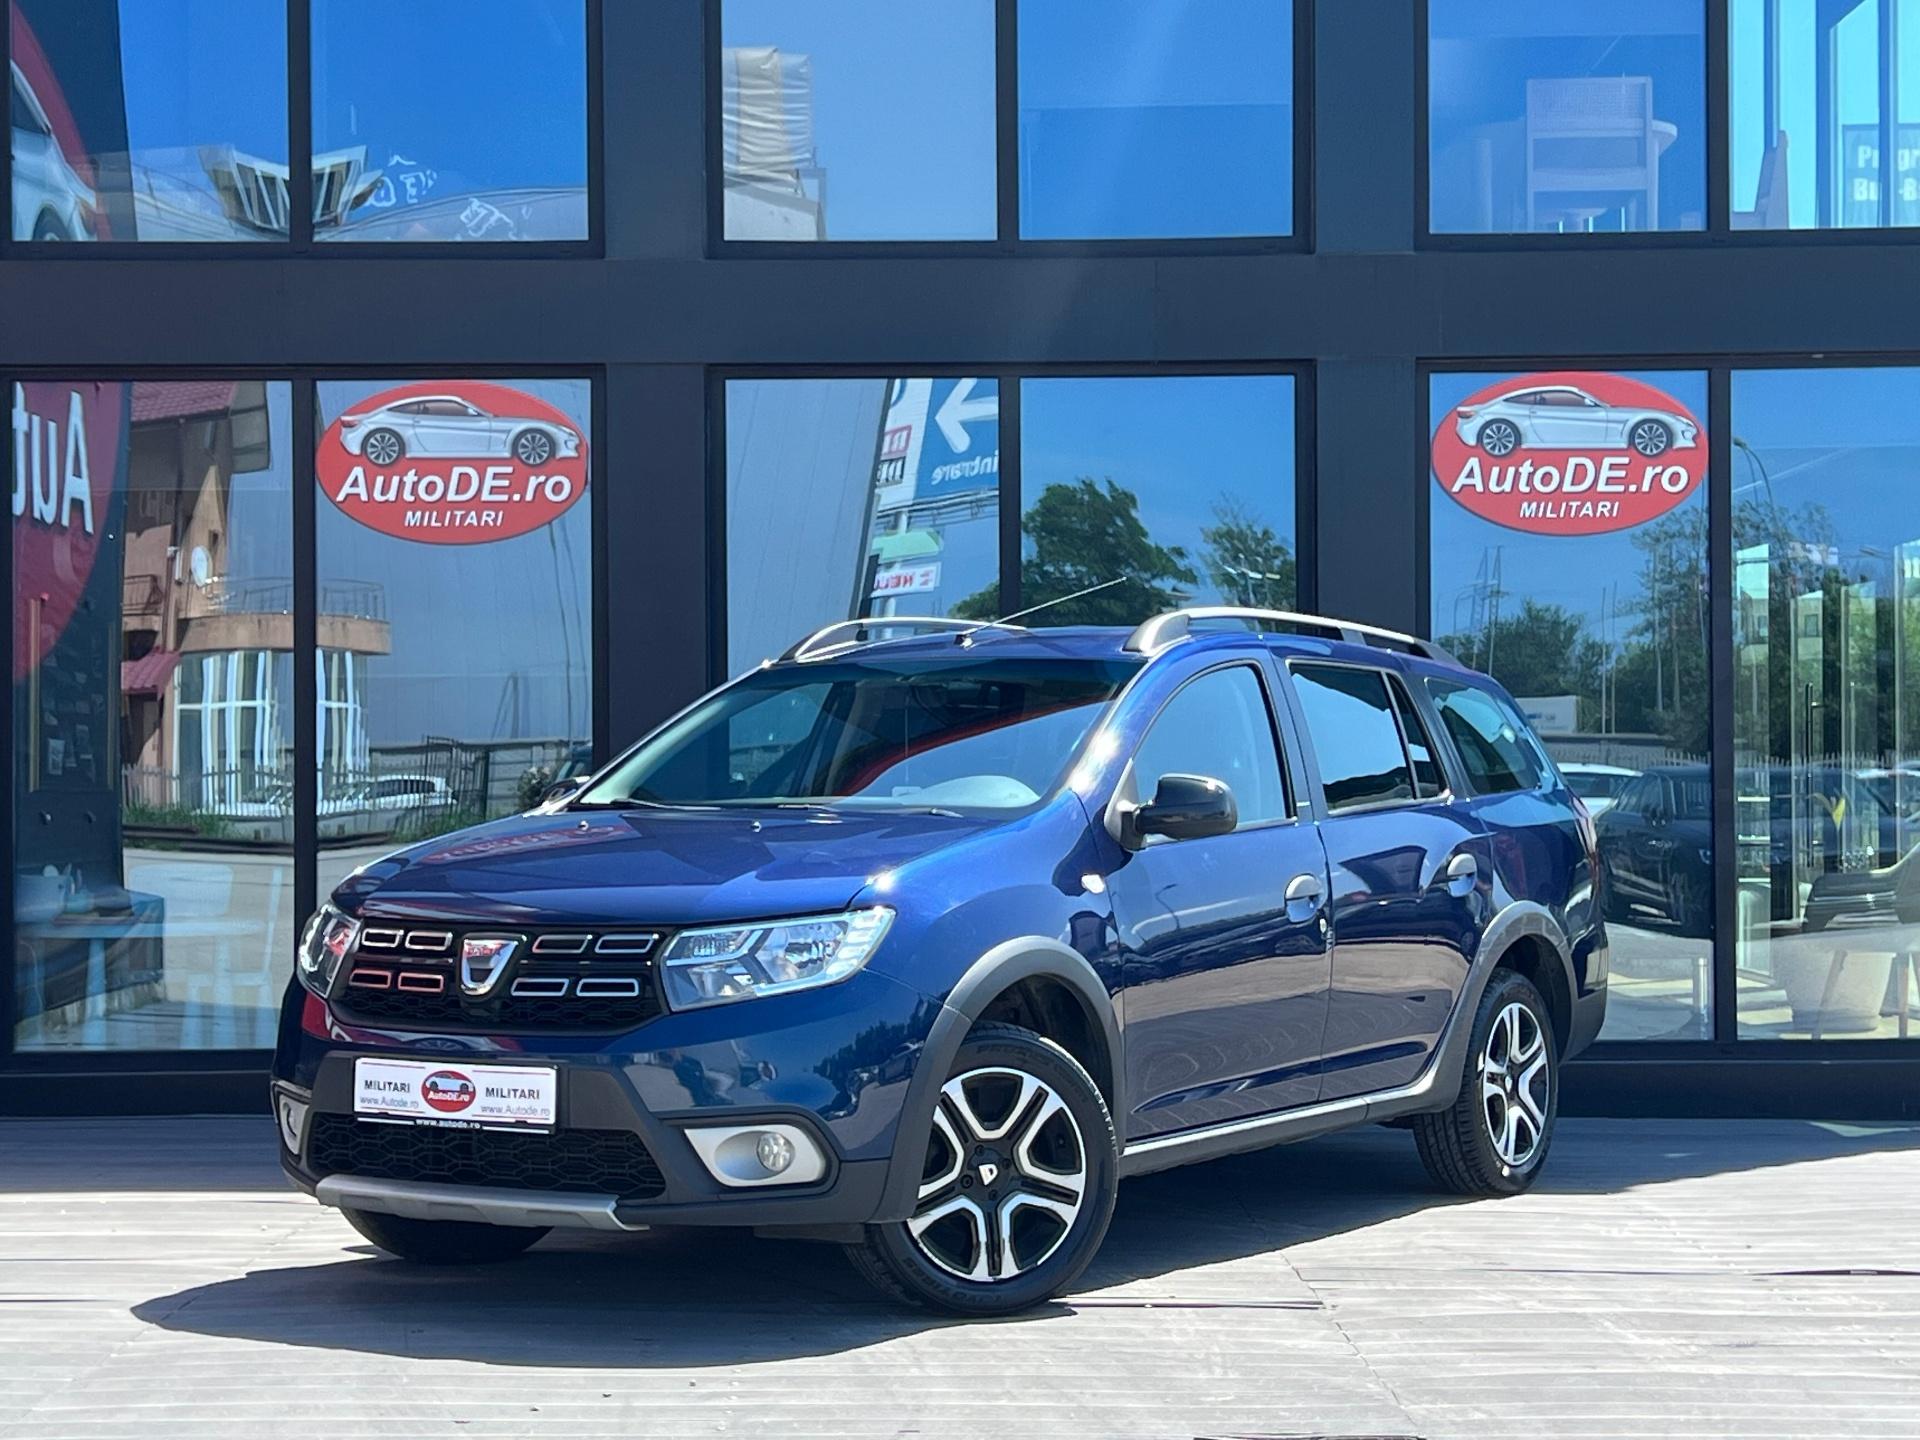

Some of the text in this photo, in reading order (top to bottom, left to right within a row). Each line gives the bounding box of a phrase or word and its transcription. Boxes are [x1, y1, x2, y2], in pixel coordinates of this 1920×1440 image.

[1452, 456, 1690, 494] AutoDE.ro
[335, 465, 573, 503] AutoDE.ro
[1519, 501, 1620, 519] MILITARI
[404, 510, 504, 527] MILITARI
[364, 1080, 410, 1094] MILITARI
[485, 1087, 540, 1101] MILITARI
[360, 1096, 419, 1109] www.Autode.ro
[427, 1090, 471, 1103] AutoDE.ro
[480, 1104, 551, 1118] www.Autode.ro
[415, 1118, 481, 1130] www.autode.ro
